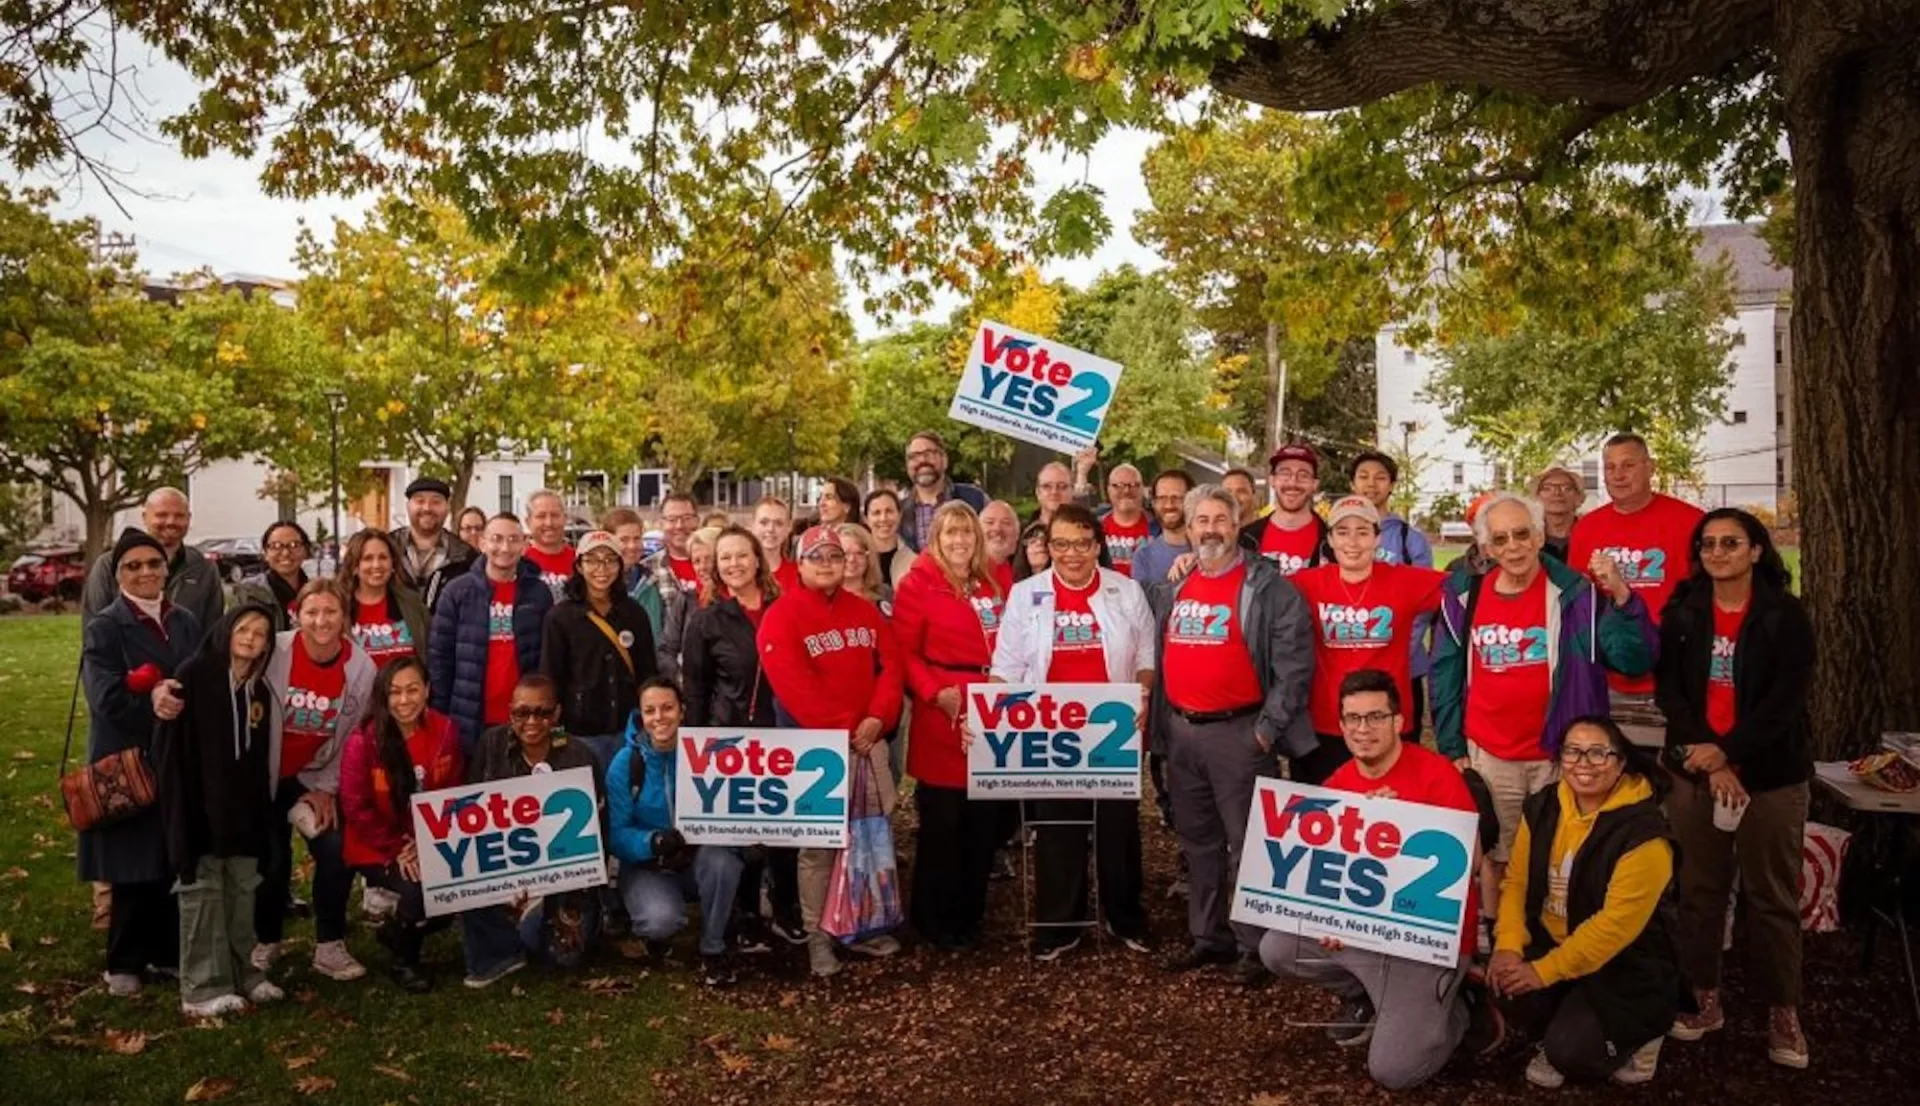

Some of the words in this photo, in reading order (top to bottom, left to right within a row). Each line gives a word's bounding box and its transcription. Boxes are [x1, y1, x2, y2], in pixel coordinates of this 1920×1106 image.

[983, 328, 1072, 387] Vote
[960, 403, 978, 414] High
[980, 364, 1059, 417] YES
[1055, 371, 1111, 434] 2
[1642, 548, 1666, 579] 2
[1206, 604, 1231, 637] 2
[1317, 602, 1369, 624] Vote
[1322, 621, 1367, 640] YES
[1368, 604, 1393, 638] 2
[803, 629, 845, 658] RED
[1523, 626, 1549, 661] 2
[971, 693, 1087, 730] Vote
[983, 731, 1082, 768] YES
[1087, 701, 1138, 768] 2
[681, 737, 794, 776] Vote
[691, 777, 789, 815] YES
[794, 747, 846, 816] 2
[977, 779, 999, 789] High
[1076, 779, 1098, 789] High
[1100, 779, 1134, 788] Stakes
[416, 791, 542, 840] Vote
[434, 827, 541, 879] YES
[542, 787, 599, 862] 2
[683, 824, 705, 835] High
[762, 826, 780, 835] Not
[781, 826, 804, 837] High
[807, 827, 840, 836] Stakes
[1259, 788, 1402, 859] Vote
[433, 891, 459, 904] High
[538, 873, 562, 885] High
[563, 867, 598, 878] Stakes
[1264, 839, 1389, 908] YES
[1391, 829, 1469, 925] 2
[1245, 899, 1273, 914] High
[1274, 904, 1343, 930] Standards,
[1345, 919, 1369, 934] Not
[1372, 924, 1401, 941] High
[1403, 931, 1449, 950] Stakes
